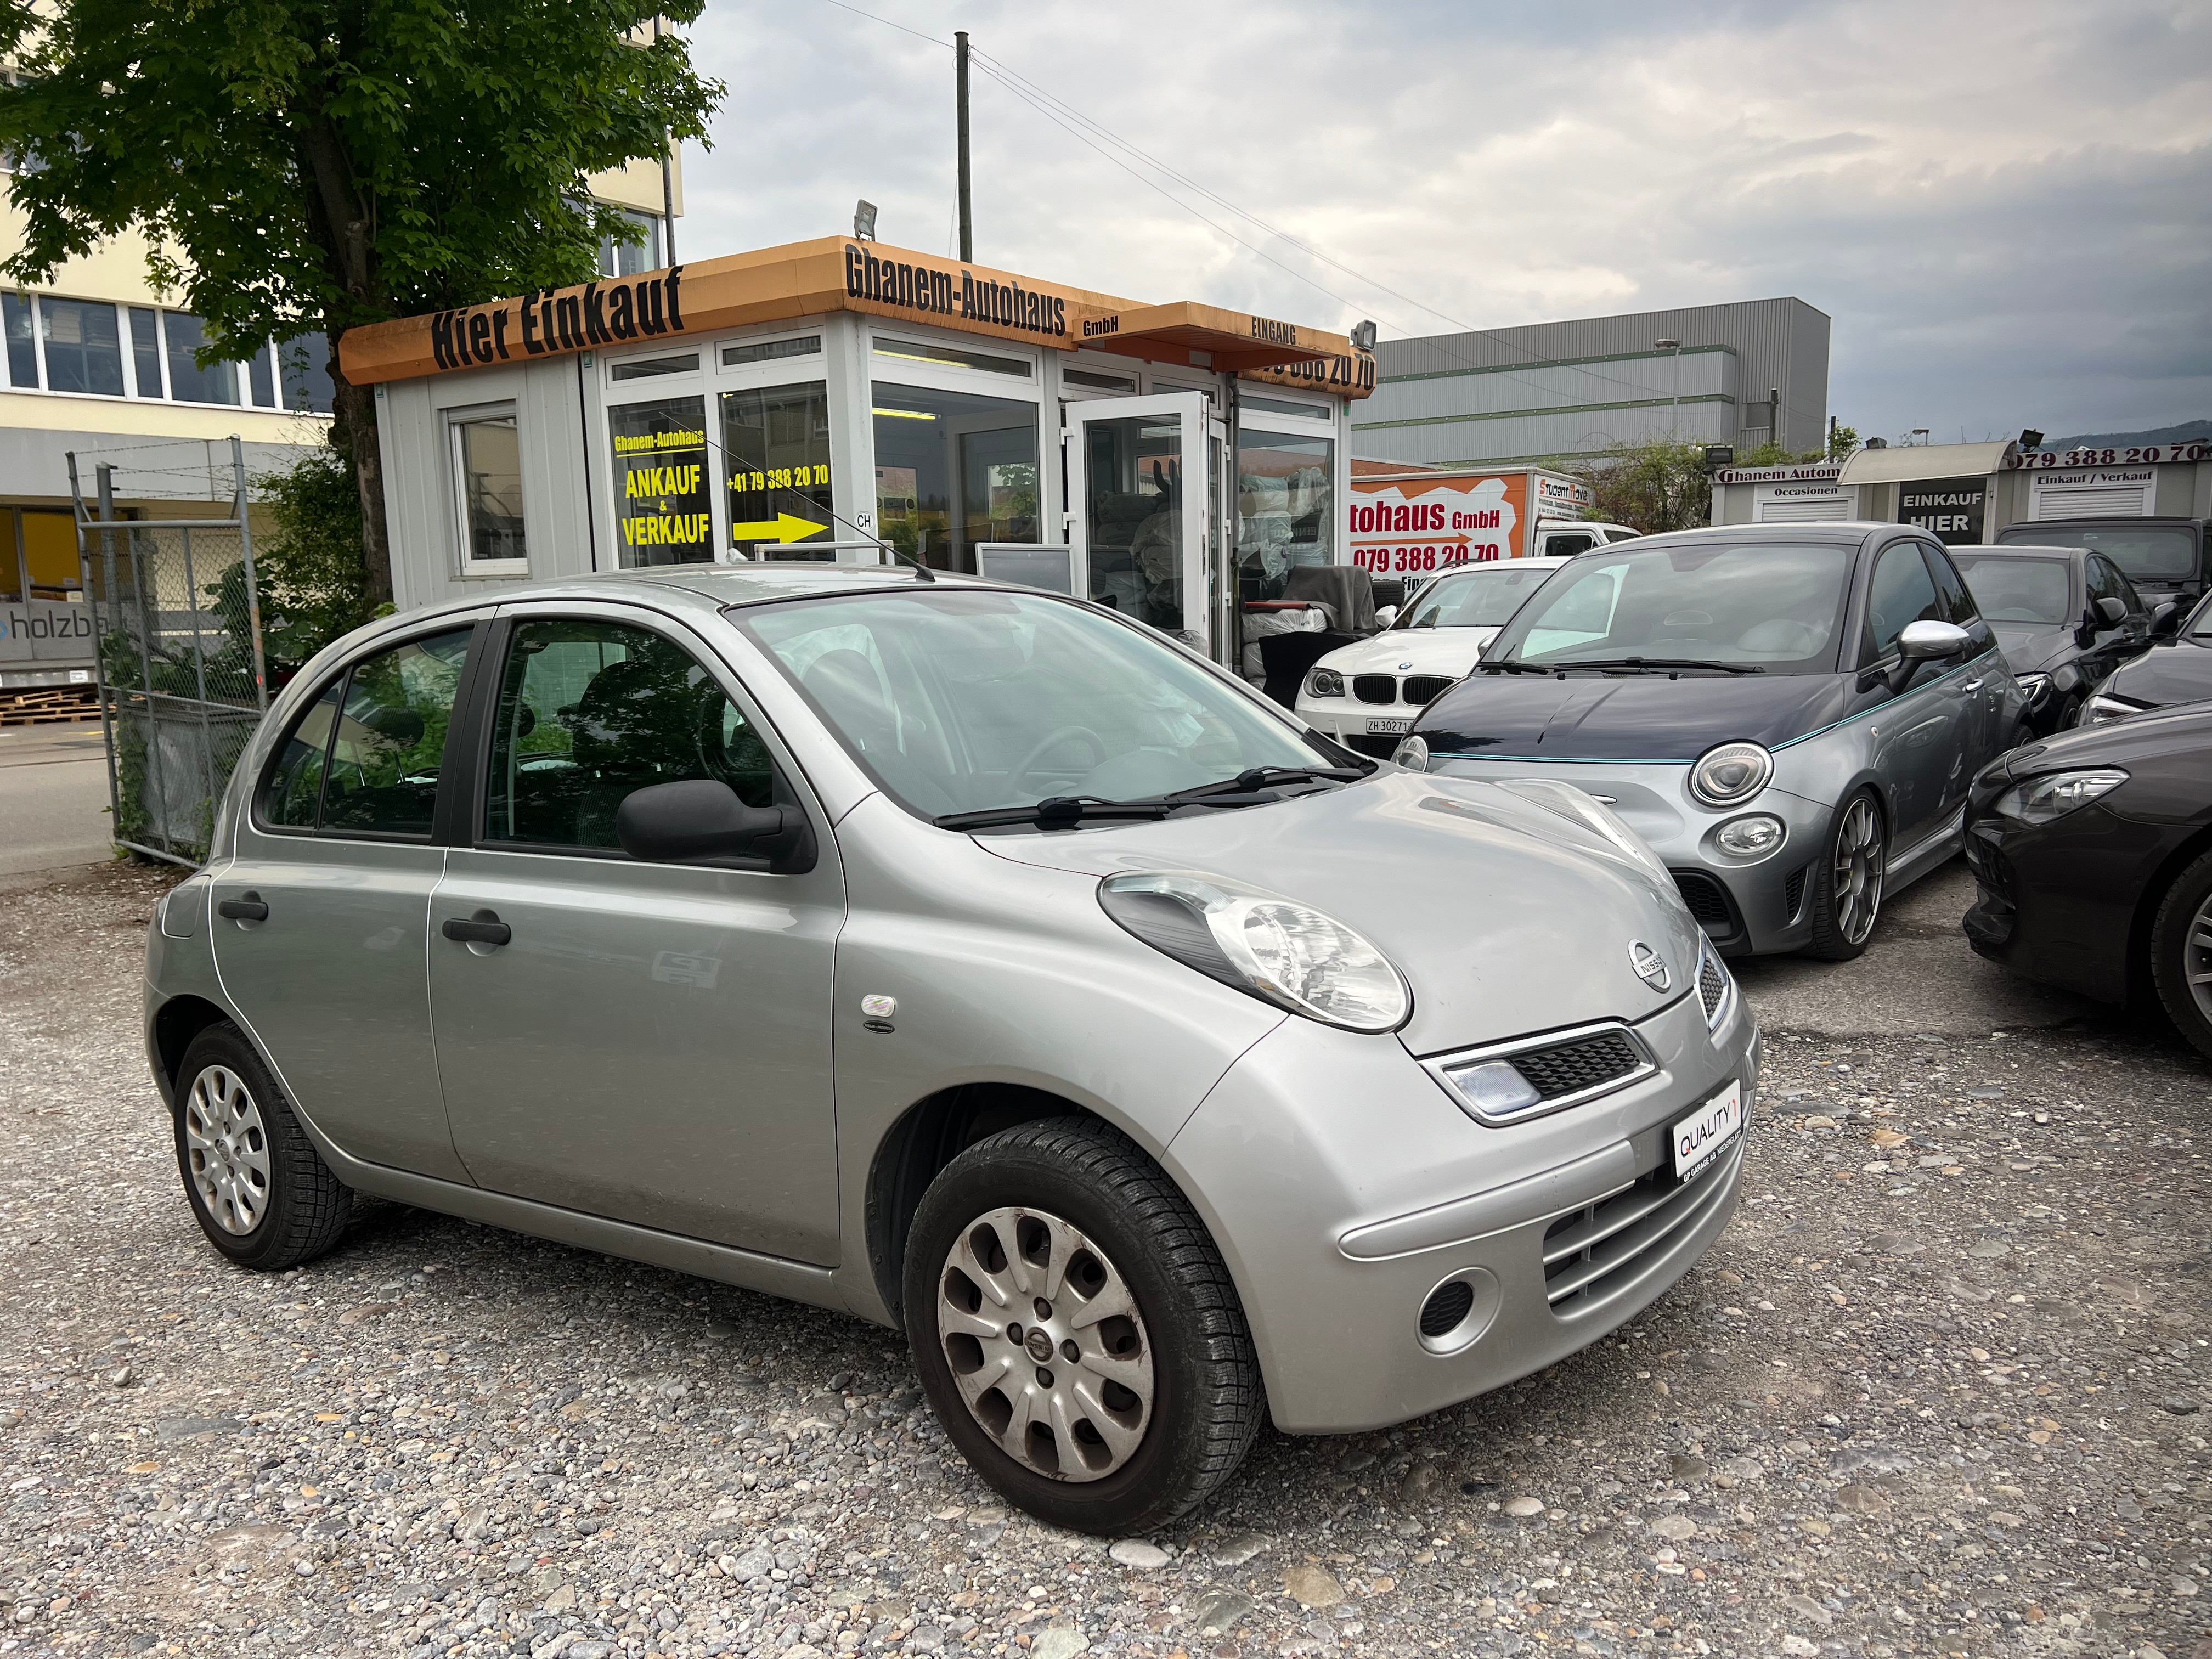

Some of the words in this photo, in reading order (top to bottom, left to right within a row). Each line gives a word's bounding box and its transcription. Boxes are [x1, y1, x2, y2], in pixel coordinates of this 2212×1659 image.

[845, 243, 1065, 337] Ghanem-Autohaus
[1082, 315, 1119, 337] GmbH
[432, 307, 510, 369] Hier
[519, 266, 685, 354] Einkauf
[1251, 316, 1296, 346] EINGANG
[1354, 352, 1376, 391] 70
[615, 429, 704, 452] Ghanem-Autohaus
[2008, 452, 2056, 469] 079
[2064, 448, 2116, 466] 388
[2126, 447, 2160, 463] 20
[2170, 445, 2204, 461] 70
[625, 464, 701, 498] ANKAUF
[727, 472, 747, 492] +41
[749, 471, 765, 491] 79
[767, 467, 792, 489] 388
[795, 466, 811, 486] 20
[812, 464, 828, 484] 70
[1719, 469, 1785, 483] Ghanem
[2038, 473, 2087, 485] Einkauf
[2089, 473, 2097, 484] /
[2101, 471, 2153, 482] Verkauf
[1774, 487, 1837, 496] Occasionen
[1903, 493, 1982, 507] EINKAUF
[659, 500, 667, 511] &
[622, 513, 709, 546] VERKAUF
[857, 514, 871, 528] CH
[1452, 510, 1500, 530] GmbH
[1910, 515, 1968, 532] HIER
[1353, 548, 1390, 572] 079
[1395, 546, 1436, 571] 388
[1442, 545, 1469, 567] 20
[1474, 543, 1499, 560] 70
[1401, 576, 1425, 591] Fin
[1368, 721, 1379, 731] ZH
[1683, 1171, 1691, 1183] GP
[1691, 1156, 1709, 1177] GARAGE
[1709, 1151, 1717, 1163] AG
